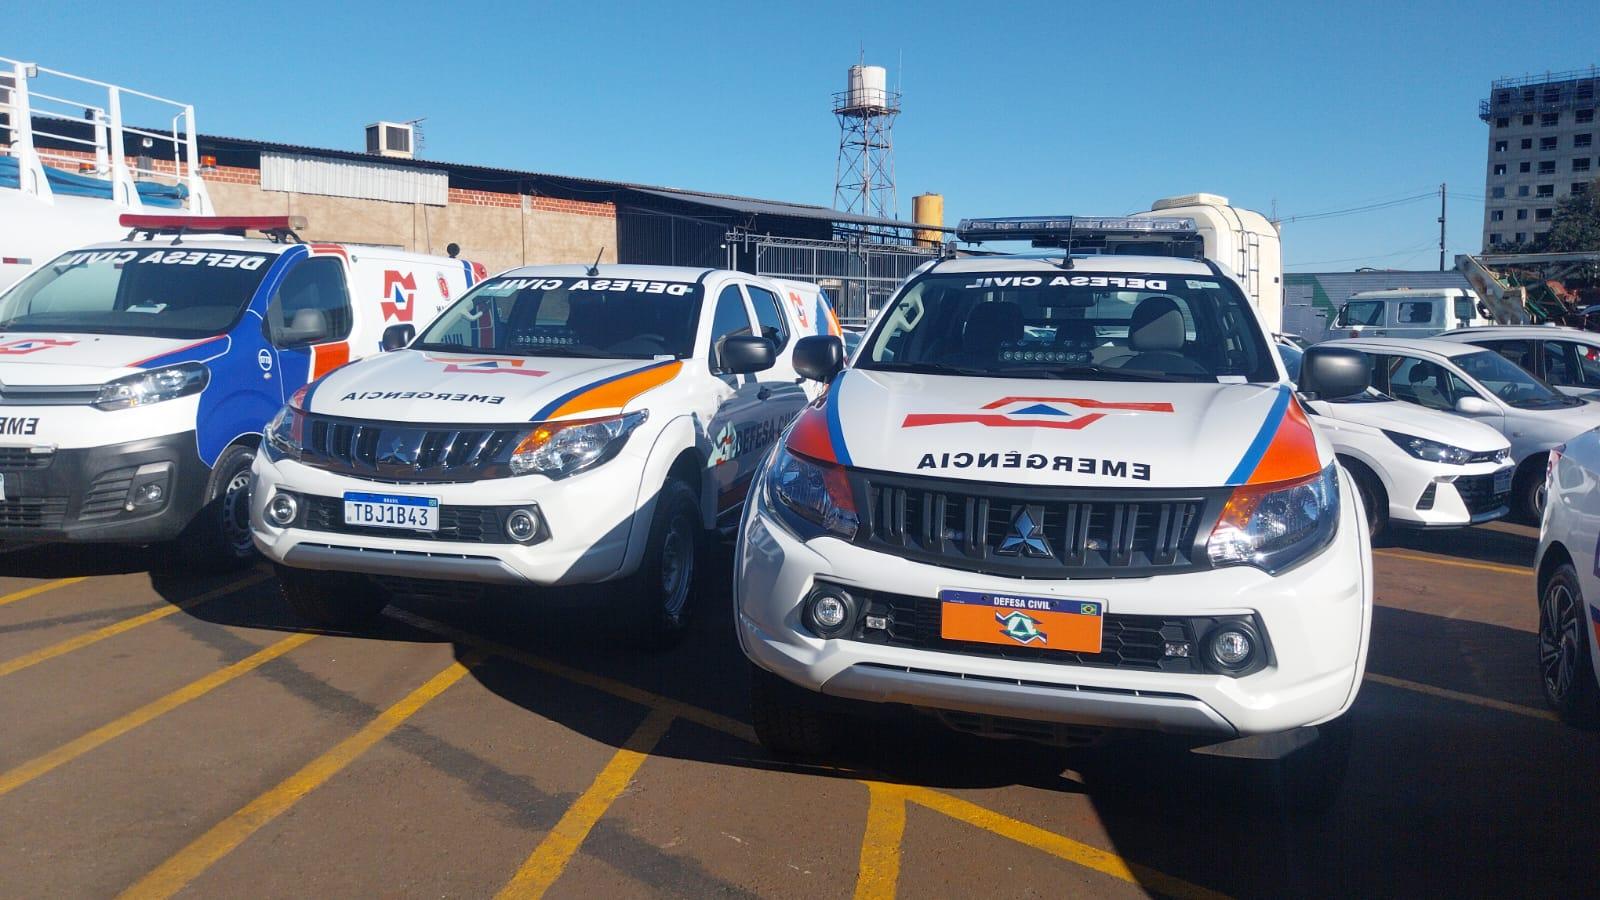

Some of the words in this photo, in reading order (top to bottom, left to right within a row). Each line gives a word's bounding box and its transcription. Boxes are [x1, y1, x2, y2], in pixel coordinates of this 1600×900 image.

[354, 503, 428, 526] TBJ1B43
[993, 596, 1026, 608] DEFESA
[1027, 599, 1051, 610] CIVIL
